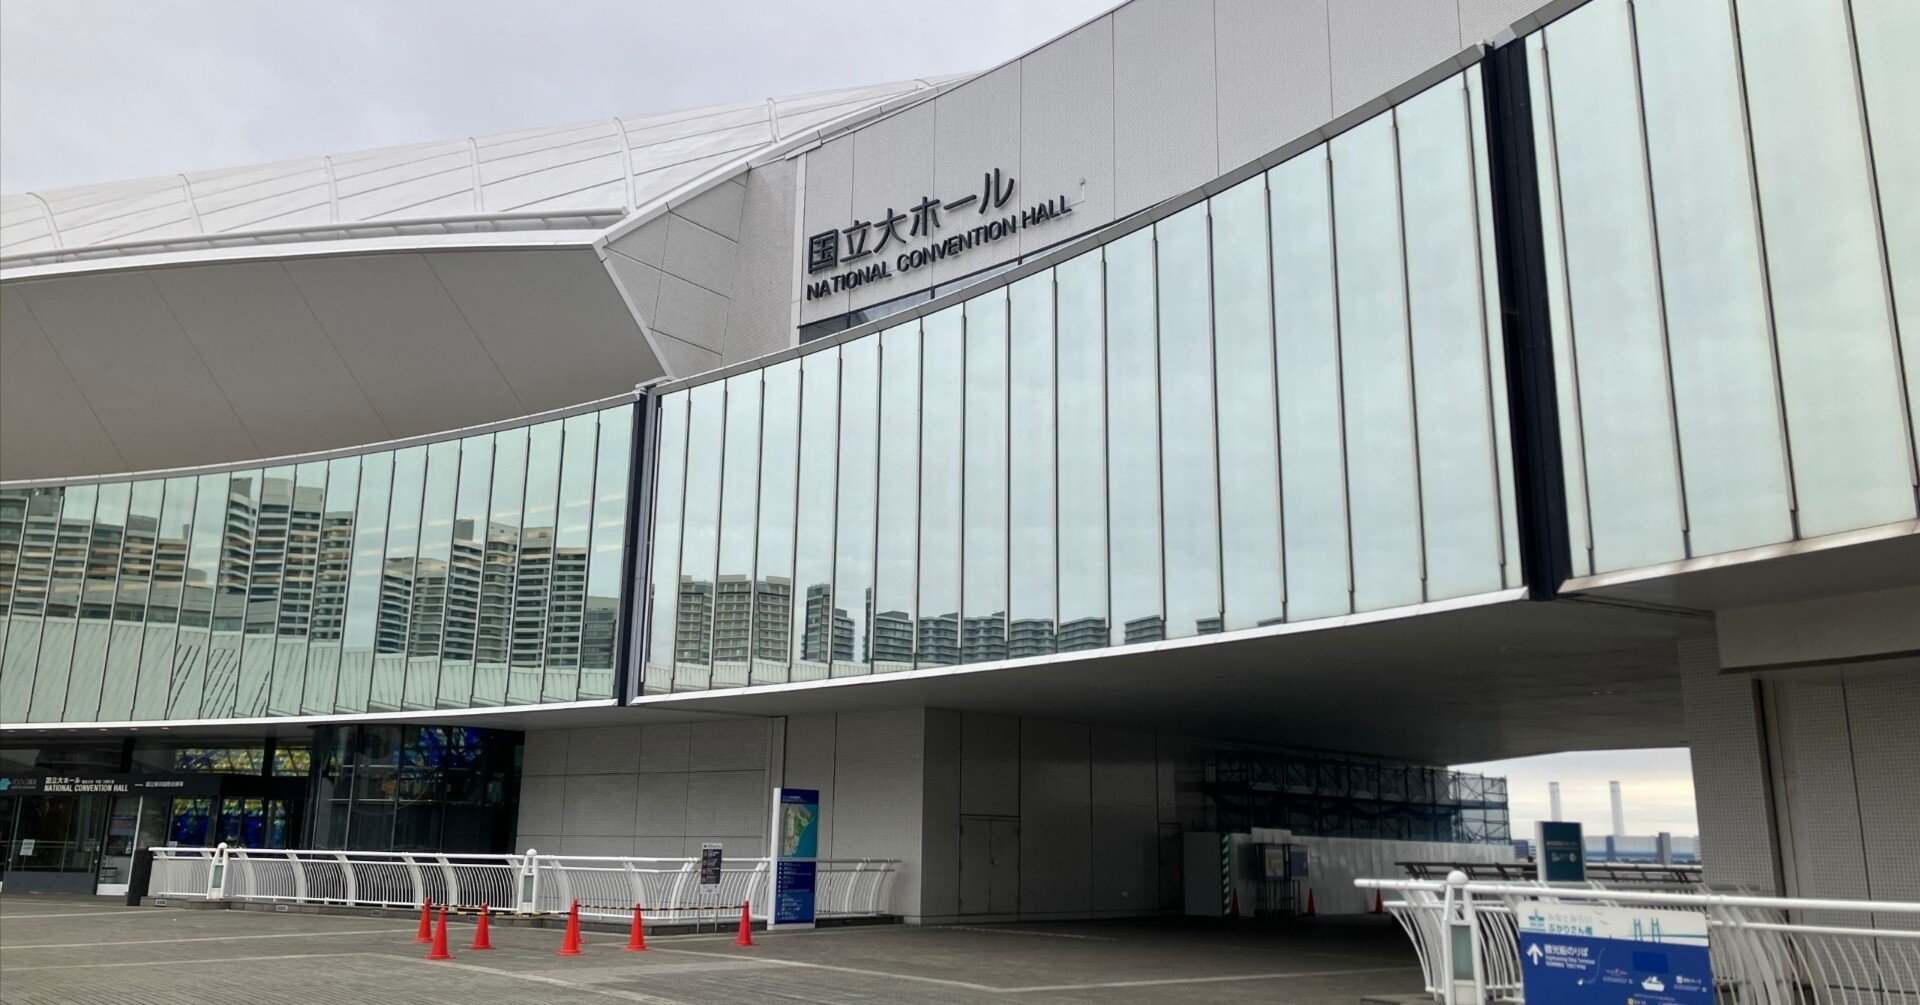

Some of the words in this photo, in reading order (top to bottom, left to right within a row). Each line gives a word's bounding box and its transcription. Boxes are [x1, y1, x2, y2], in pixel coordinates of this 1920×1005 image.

[806, 260, 892, 301] NATIONAL
[896, 214, 1016, 273] CONVENTION
[1021, 194, 1072, 230] HALL
[807, 167, 1015, 275] 国立大ホール
[44, 784, 73, 792] NATIONAL
[74, 784, 113, 792] CONVENTION
[113, 784, 128, 792] HALL
